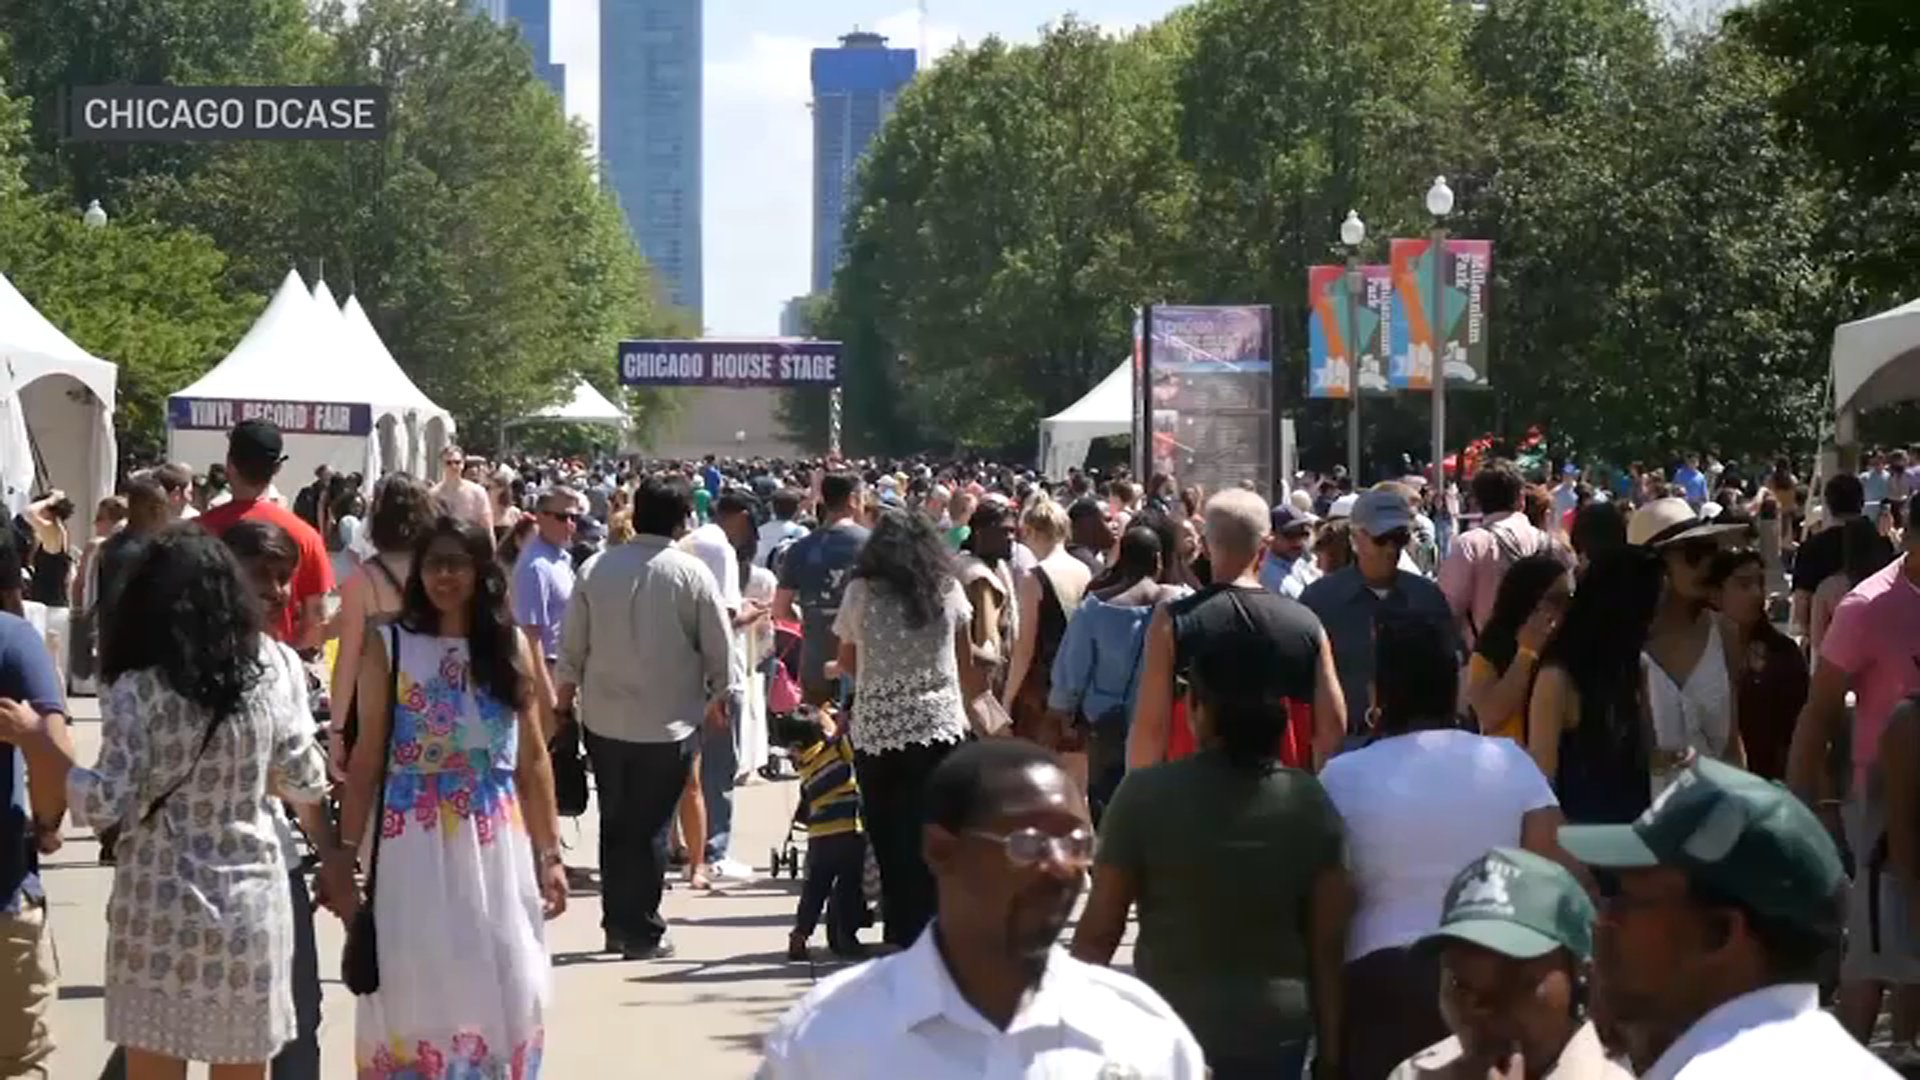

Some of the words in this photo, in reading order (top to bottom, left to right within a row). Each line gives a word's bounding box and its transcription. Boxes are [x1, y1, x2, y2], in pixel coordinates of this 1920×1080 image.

[1455, 252, 1470, 288] Park
[623, 352, 704, 378] CHICAGO
[711, 353, 773, 379] HOUSE
[779, 354, 836, 380] STAGE
[190, 400, 235, 427] VINYL
[242, 402, 308, 430] RECORD
[314, 404, 351, 432] FAIR
